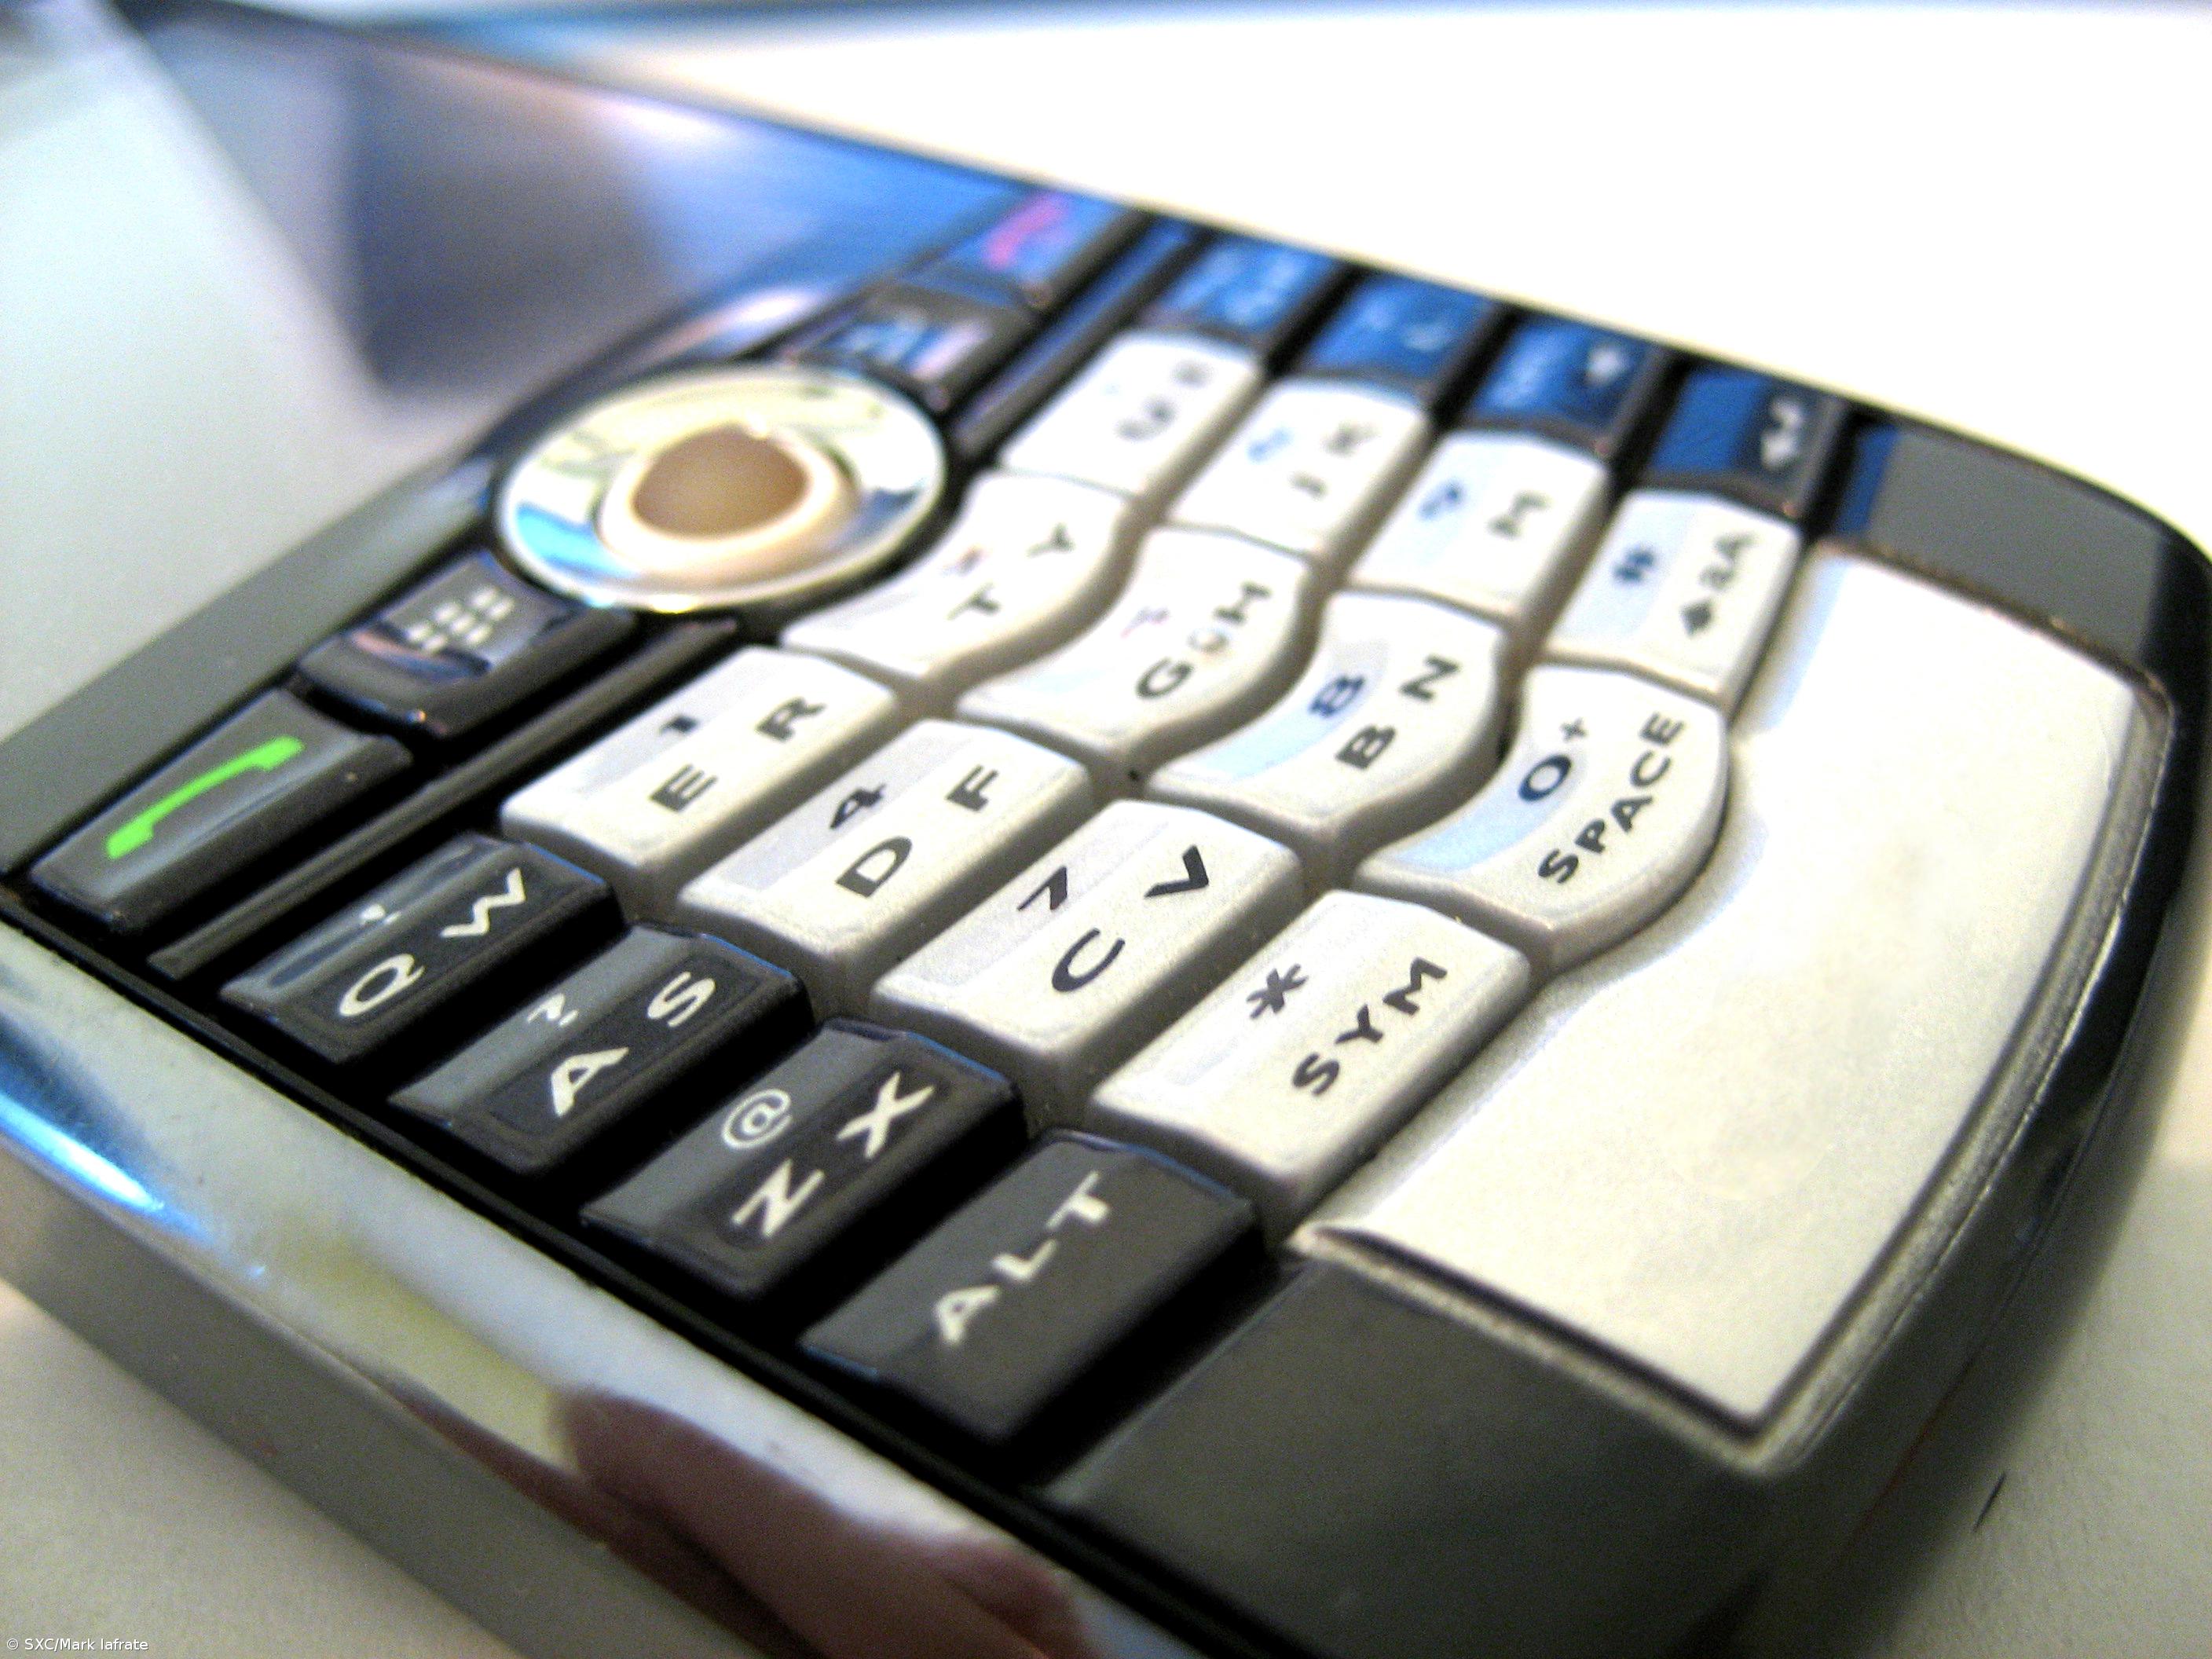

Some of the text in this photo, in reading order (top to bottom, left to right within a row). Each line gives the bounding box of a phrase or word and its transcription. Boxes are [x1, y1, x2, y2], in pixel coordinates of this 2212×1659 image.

[1135, 657, 1195, 700] G
[1214, 581, 1271, 628] H
[649, 697, 827, 813] E R
[1335, 655, 1460, 771] B N
[829, 782, 887, 830] 4
[836, 764, 999, 899] D F
[1538, 712, 1684, 885] SPACE
[338, 867, 526, 1018] Q W
[1017, 865, 1069, 912] 7
[1051, 844, 1210, 994] C V
[550, 971, 716, 1117] A S
[1292, 958, 1448, 1096] SYM
[721, 1089, 792, 1149] @
[731, 1071, 934, 1237] Z X
[935, 1170, 1109, 1344] ALT
